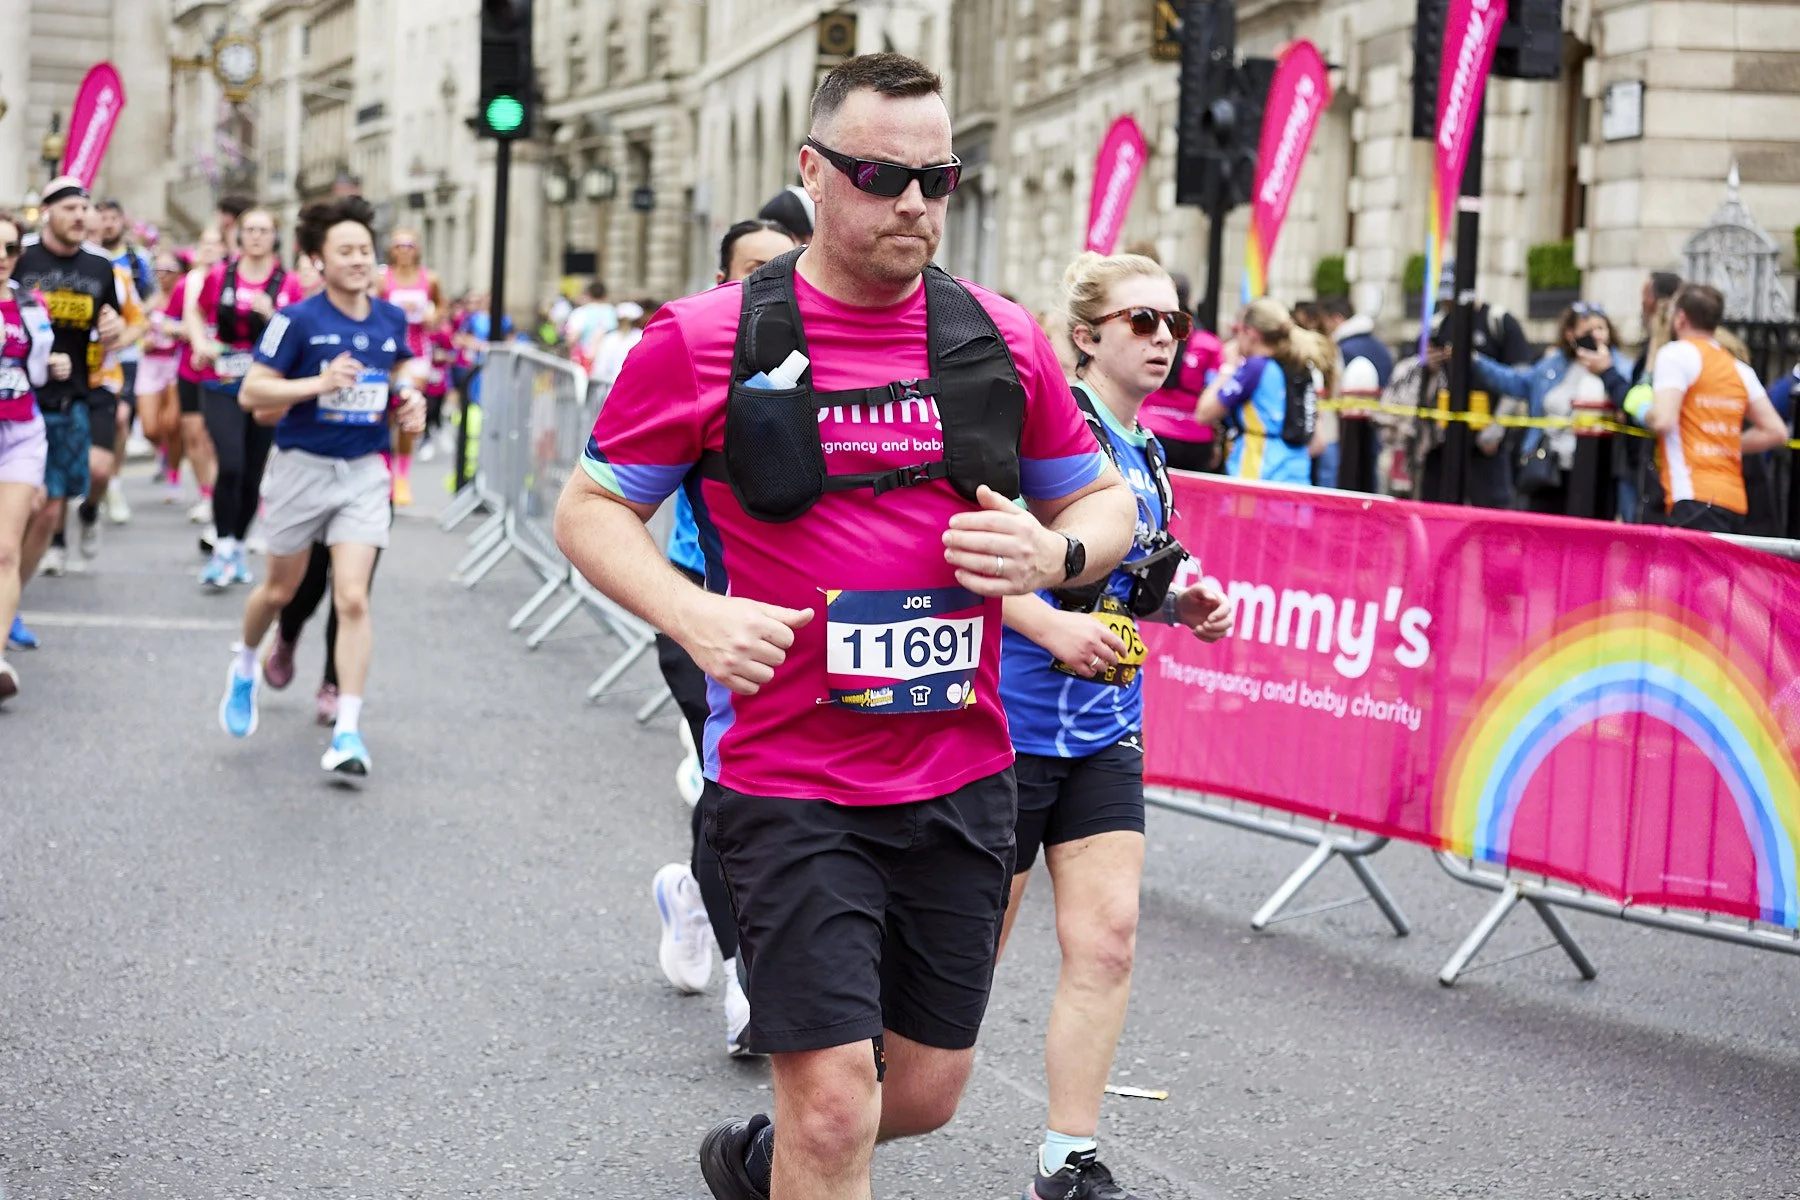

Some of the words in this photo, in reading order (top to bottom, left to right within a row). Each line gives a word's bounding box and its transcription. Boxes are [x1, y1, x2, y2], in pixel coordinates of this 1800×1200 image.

[821, 441, 878, 454] gnancy
[881, 438, 909, 452] and
[902, 595, 932, 610] JOE
[843, 623, 973, 669] 11691
[1158, 654, 1183, 682] The
[1183, 664, 1262, 703] pregnancy
[1261, 678, 1298, 705] and
[1299, 680, 1349, 719] baby
[1350, 691, 1422, 732] charity
